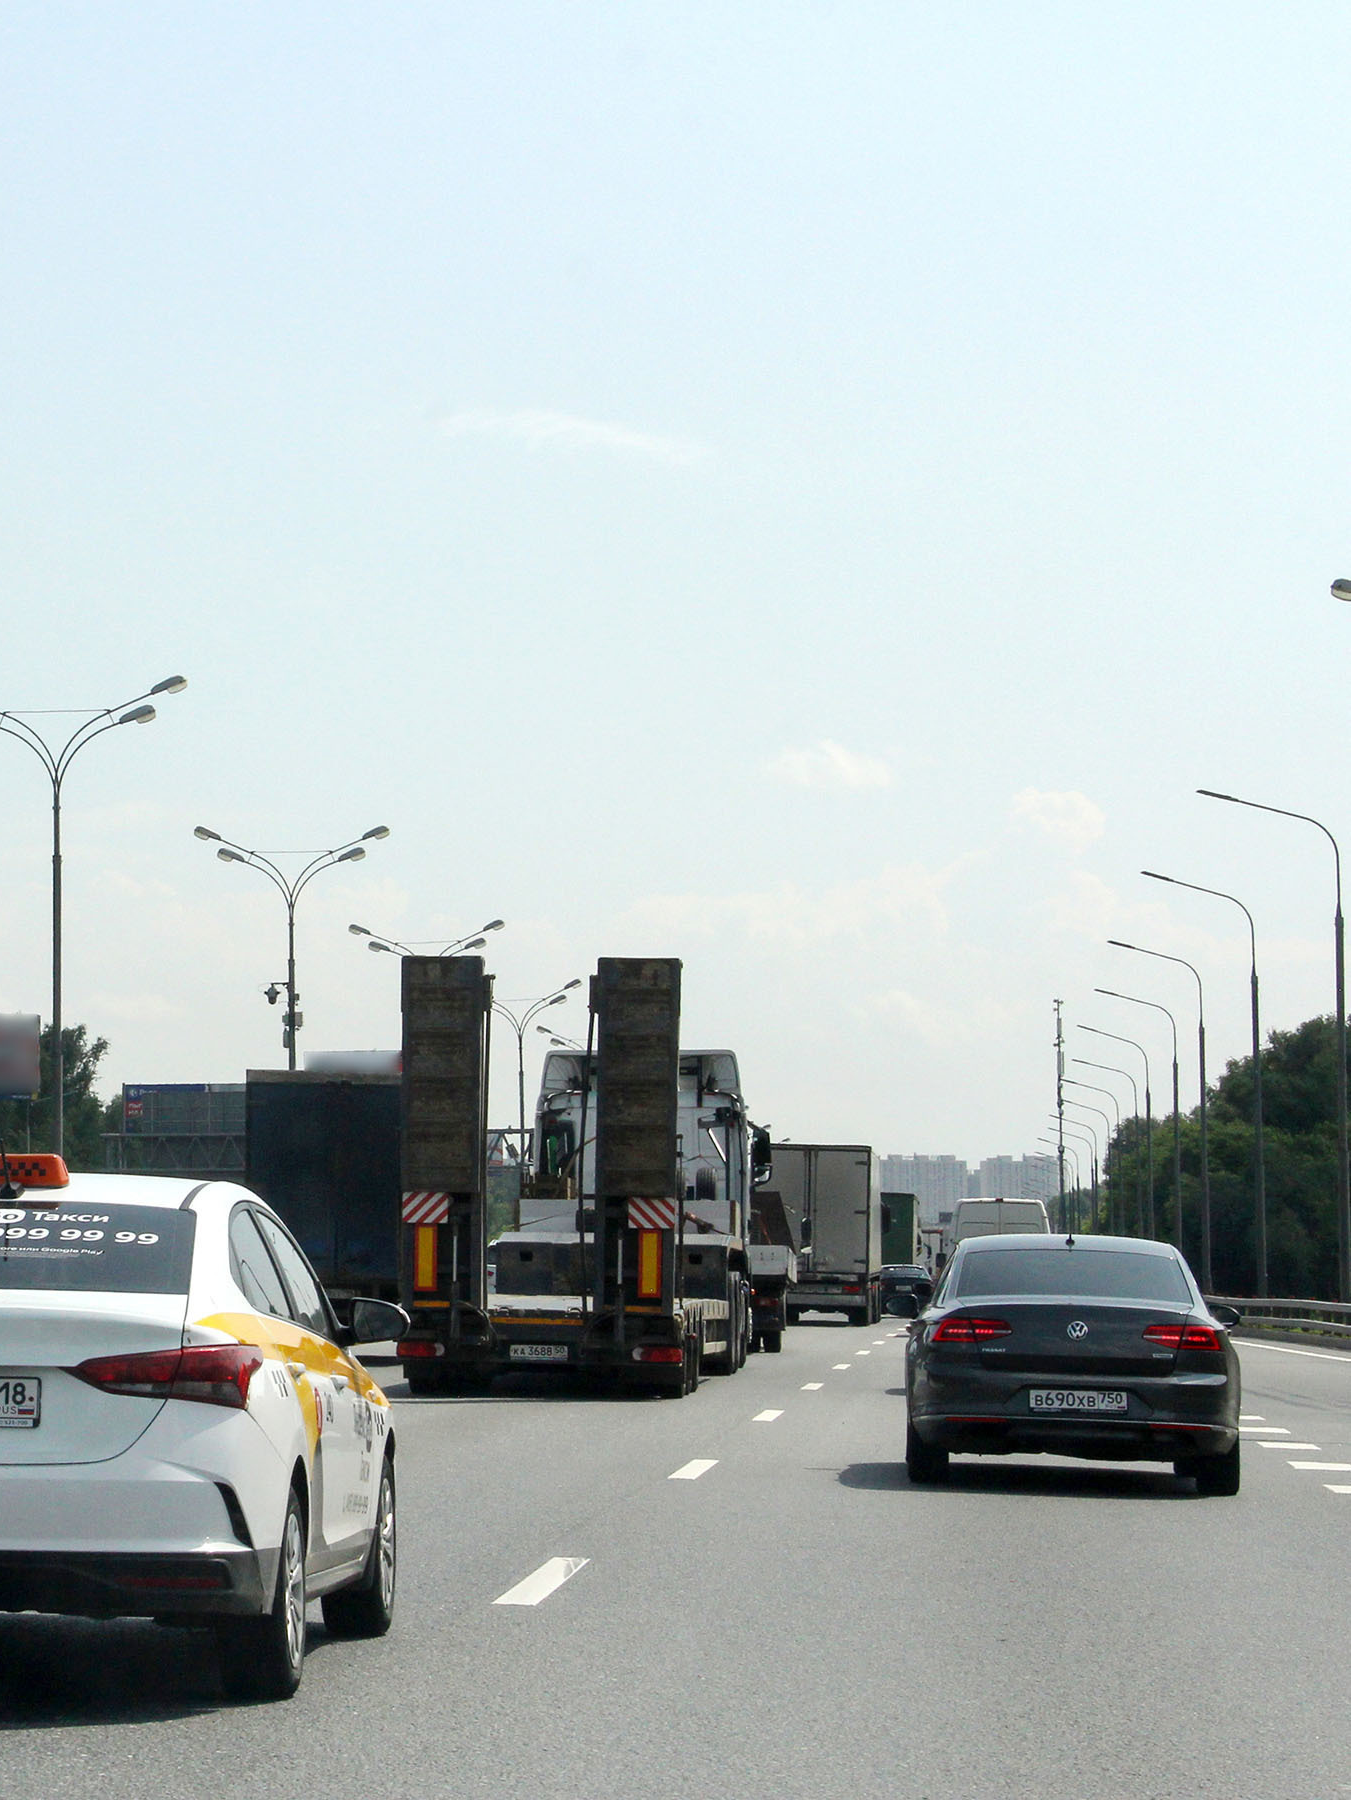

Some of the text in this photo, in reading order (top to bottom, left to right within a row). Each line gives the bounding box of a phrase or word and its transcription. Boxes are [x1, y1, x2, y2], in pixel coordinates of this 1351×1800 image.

[32, 1211, 110, 1223] Такси
[59, 1229, 105, 1242] 99
[114, 1231, 159, 1245] 99
[1034, 1391, 1123, 1408] В690ХВ 750
